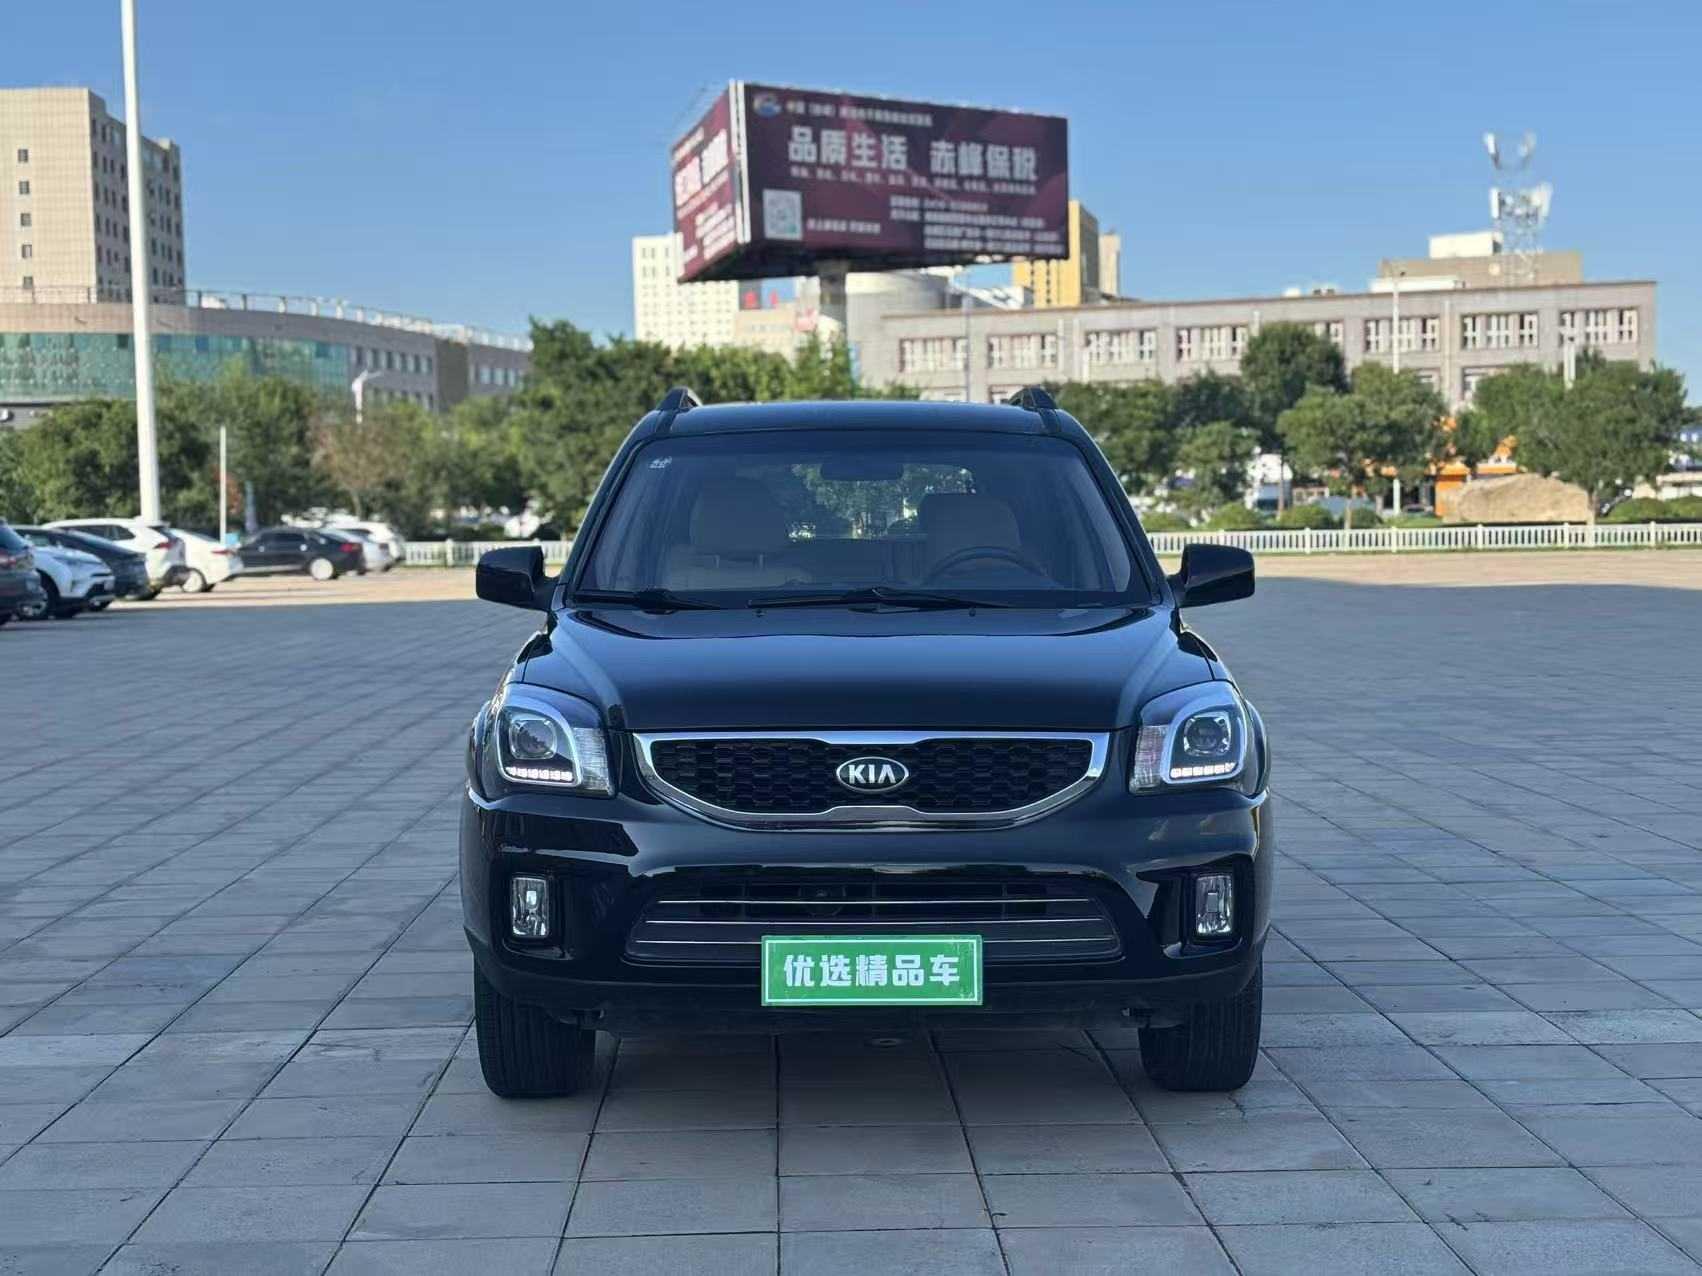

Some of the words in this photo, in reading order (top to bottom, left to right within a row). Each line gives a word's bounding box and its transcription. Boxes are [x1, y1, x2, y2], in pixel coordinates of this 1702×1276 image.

[788, 126, 908, 171] 品质生活
[929, 140, 1038, 181] 赤峰保税
[848, 764, 897, 784] KIA
[783, 954, 961, 987] 优选精品车
